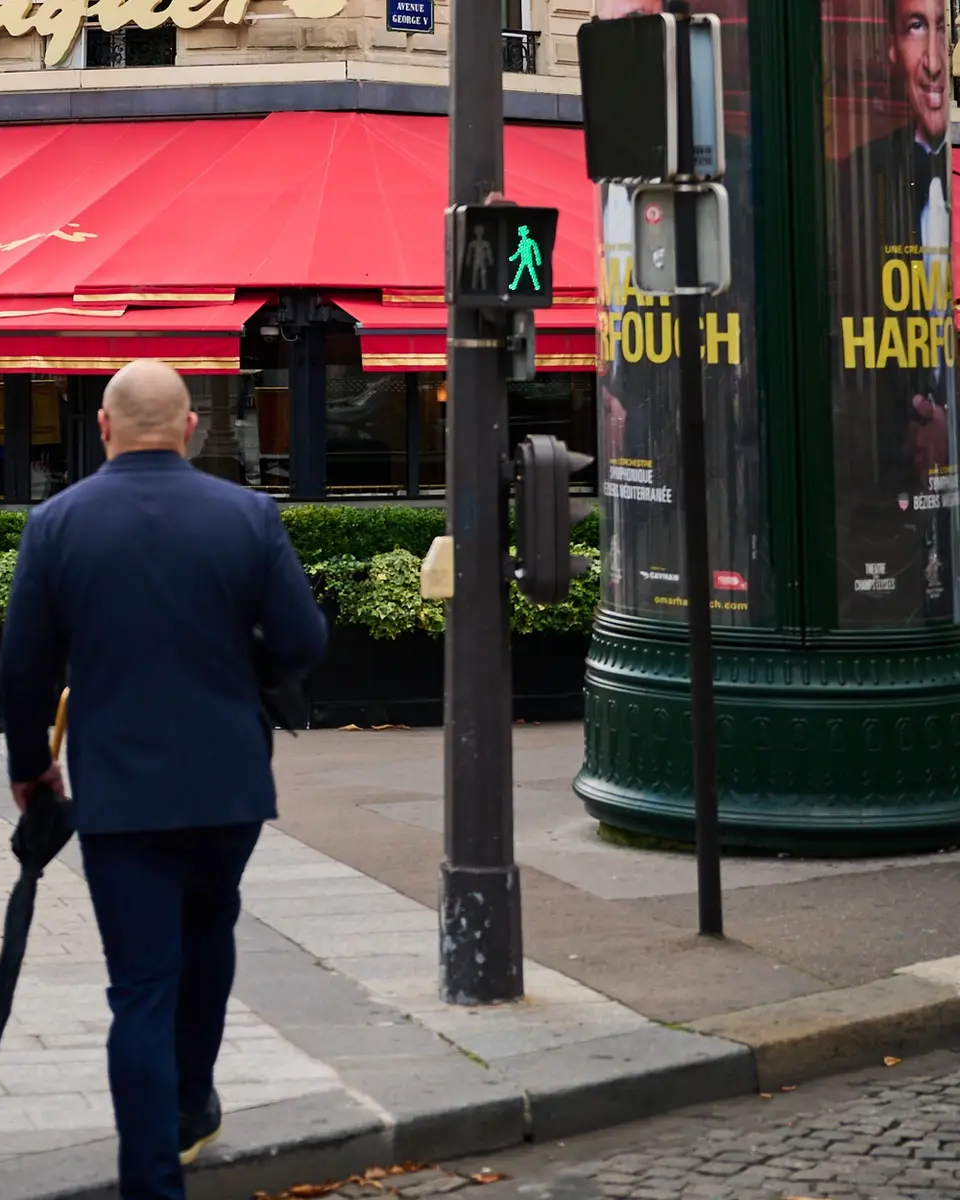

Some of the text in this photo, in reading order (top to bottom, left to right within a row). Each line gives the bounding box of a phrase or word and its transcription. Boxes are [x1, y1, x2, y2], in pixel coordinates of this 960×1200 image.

[397, 2, 424, 13] AVENUE
[392, 14, 429, 25] GEORGE V
[885, 246, 902, 254] UNE
